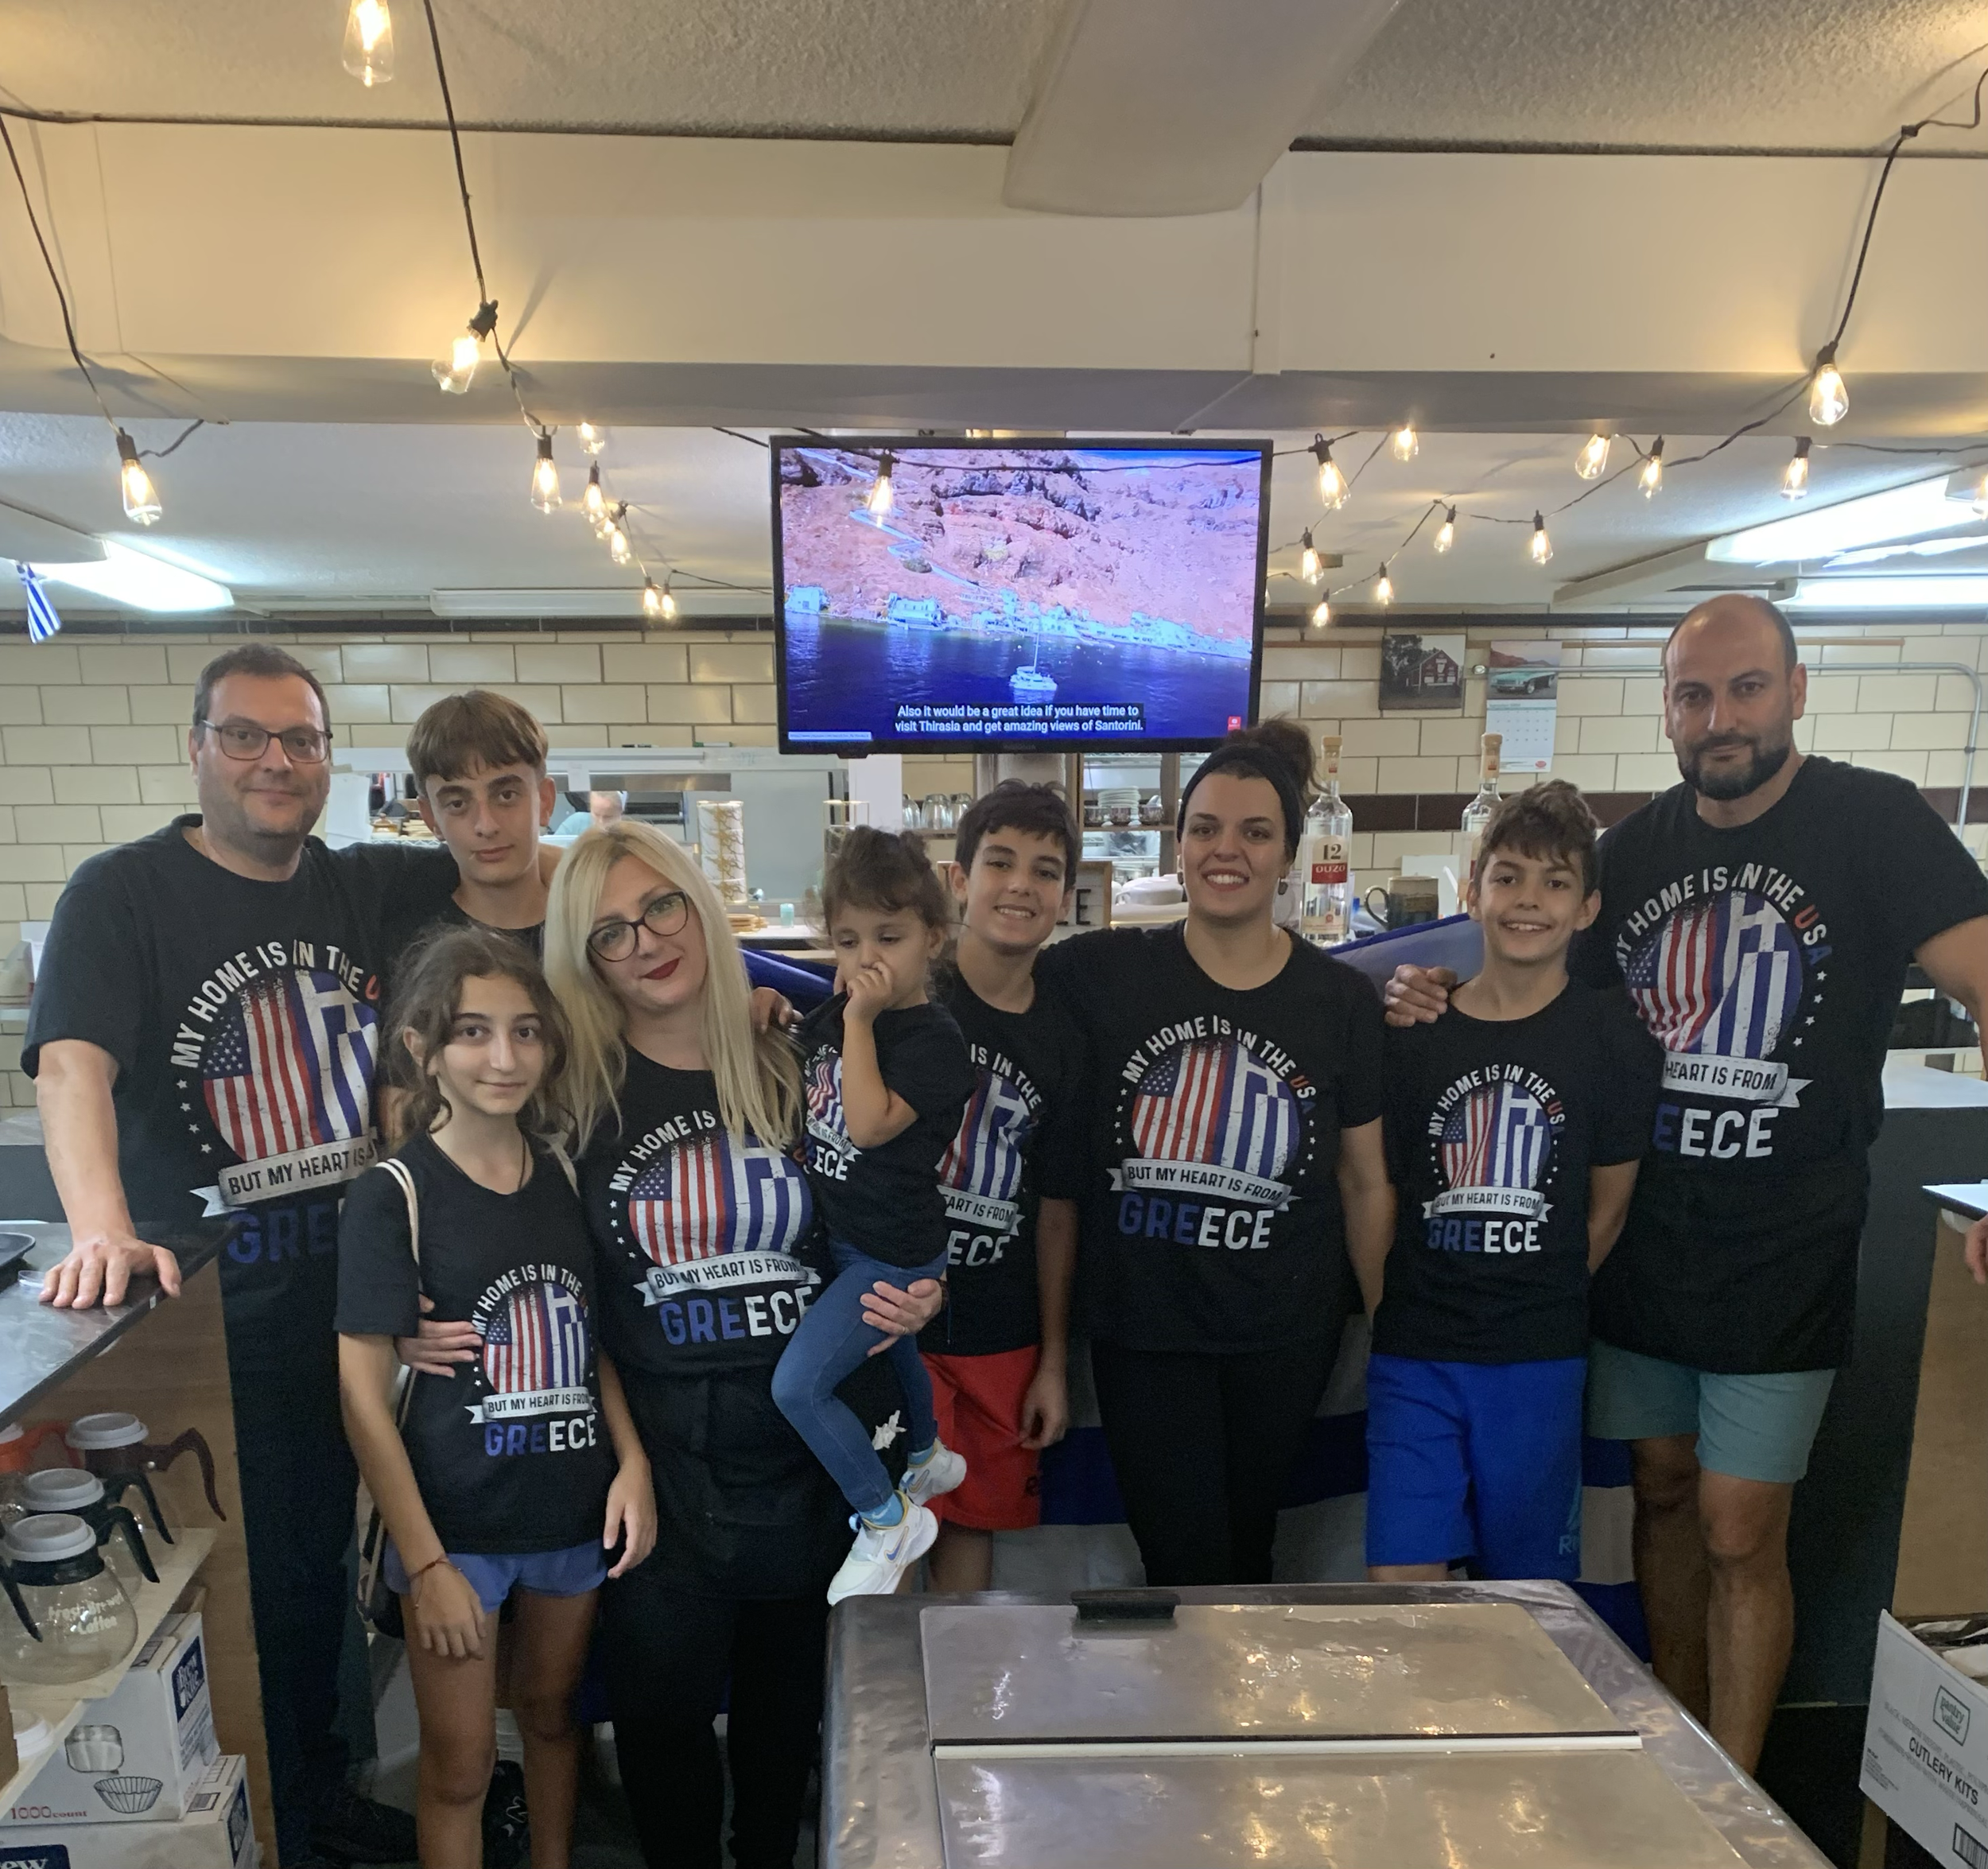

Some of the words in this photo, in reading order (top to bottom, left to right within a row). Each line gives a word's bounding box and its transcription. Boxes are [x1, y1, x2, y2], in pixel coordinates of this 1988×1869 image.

[895, 720, 917, 732] visit
[918, 720, 961, 732] Thirasia
[962, 720, 982, 732] and
[984, 721, 1002, 734] get
[1003, 720, 1048, 733] amazing
[1050, 720, 1080, 731] views
[1081, 719, 1093, 731] of
[1095, 719, 1143, 731] Santorini.
[897, 705, 922, 717] Also
[923, 705, 932, 717] it
[933, 705, 965, 717] would
[967, 705, 980, 717] be
[982, 707, 989, 717] a
[992, 705, 1018, 718] great
[1020, 705, 1043, 717] idea
[1045, 705, 1053, 716] if
[1054, 706, 1074, 718] you
[1075, 705, 1101, 716] have
[1102, 705, 1126, 716] time
[1128, 705, 1139, 716] to
[1315, 865, 1346, 873] OUZO
[1322, 844, 1342, 861] 12
[1627, 873, 1695, 937] HOME
[1702, 865, 1728, 894] IS
[1731, 862, 1763, 891] IN
[1762, 867, 1804, 911] THE
[1794, 904, 1832, 965] USA
[170, 1023, 205, 1068] MY
[188, 951, 259, 1023] HOME
[255, 941, 288, 969] IS
[293, 939, 315, 969] IN
[326, 945, 364, 993] THE
[970, 1043, 988, 1065] IS
[992, 1052, 1012, 1076] IN
[1016, 1070, 1042, 1109] THE
[1122, 1049, 1149, 1084] MY
[1146, 1016, 1207, 1055] HOME
[1213, 1015, 1231, 1035] IS
[1237, 1028, 1257, 1051] IN
[1259, 1040, 1296, 1077] THE
[1290, 1074, 1317, 1113] USA
[1665, 1062, 1708, 1086] HEART
[1712, 1066, 1727, 1085] IS
[1732, 1069, 1777, 1091] FROM
[1428, 1112, 1446, 1137] MY
[1438, 1070, 1483, 1111] HOME
[1485, 1063, 1500, 1082] IS
[1504, 1063, 1524, 1082] IN
[1524, 1072, 1555, 1103] THE
[1547, 1100, 1565, 1136] USA
[827, 1130, 848, 1149] FROM
[1652, 1102, 1780, 1159] EECE
[609, 1160, 638, 1192] MY
[630, 1115, 692, 1160] HOME
[693, 1109, 716, 1131] IS
[813, 1144, 848, 1181] ECE
[227, 1171, 262, 1196] BUT
[268, 1163, 293, 1187] MY
[300, 1150, 350, 1181] HEART
[352, 1147, 366, 1168] IS
[1128, 1166, 1151, 1180] BUT
[1155, 1168, 1177, 1182] MY
[1180, 1169, 1226, 1188] HEART
[1228, 1177, 1241, 1191] IS
[1244, 1183, 1283, 1202] FROM
[947, 1196, 972, 1214] ART
[973, 1203, 984, 1217] IS
[987, 1206, 1014, 1222] FROM
[1435, 1194, 1450, 1208] BUT
[1452, 1194, 1465, 1205] MY
[1466, 1194, 1499, 1205] HEART
[1501, 1195, 1511, 1206] IS
[1513, 1196, 1540, 1210] FROM
[226, 1203, 336, 1265] GRE
[1117, 1192, 1275, 1250] GREECE
[1427, 1218, 1542, 1253] GREECE
[947, 1230, 1010, 1267] ECE
[521, 1264, 538, 1282] IS
[541, 1264, 557, 1281] IN
[561, 1268, 583, 1297] THE
[654, 1272, 680, 1289] BUT
[681, 1268, 701, 1284] MY
[705, 1260, 746, 1280] HEART
[749, 1259, 763, 1274] IS
[766, 1257, 798, 1273] FROM
[477, 1269, 521, 1312] HOME
[472, 1310, 488, 1335] MY
[487, 1401, 507, 1413] BUT
[511, 1397, 526, 1411] MY
[529, 1395, 559, 1409] HEART
[562, 1394, 571, 1405] IS
[484, 1414, 596, 1456] GREECE
[1909, 1737, 1953, 1782] CUTLERY
[1955, 1775, 1978, 1805] KITS
[10, 1806, 52, 1820] 1000
[0, 1859, 48, 1869] ew
